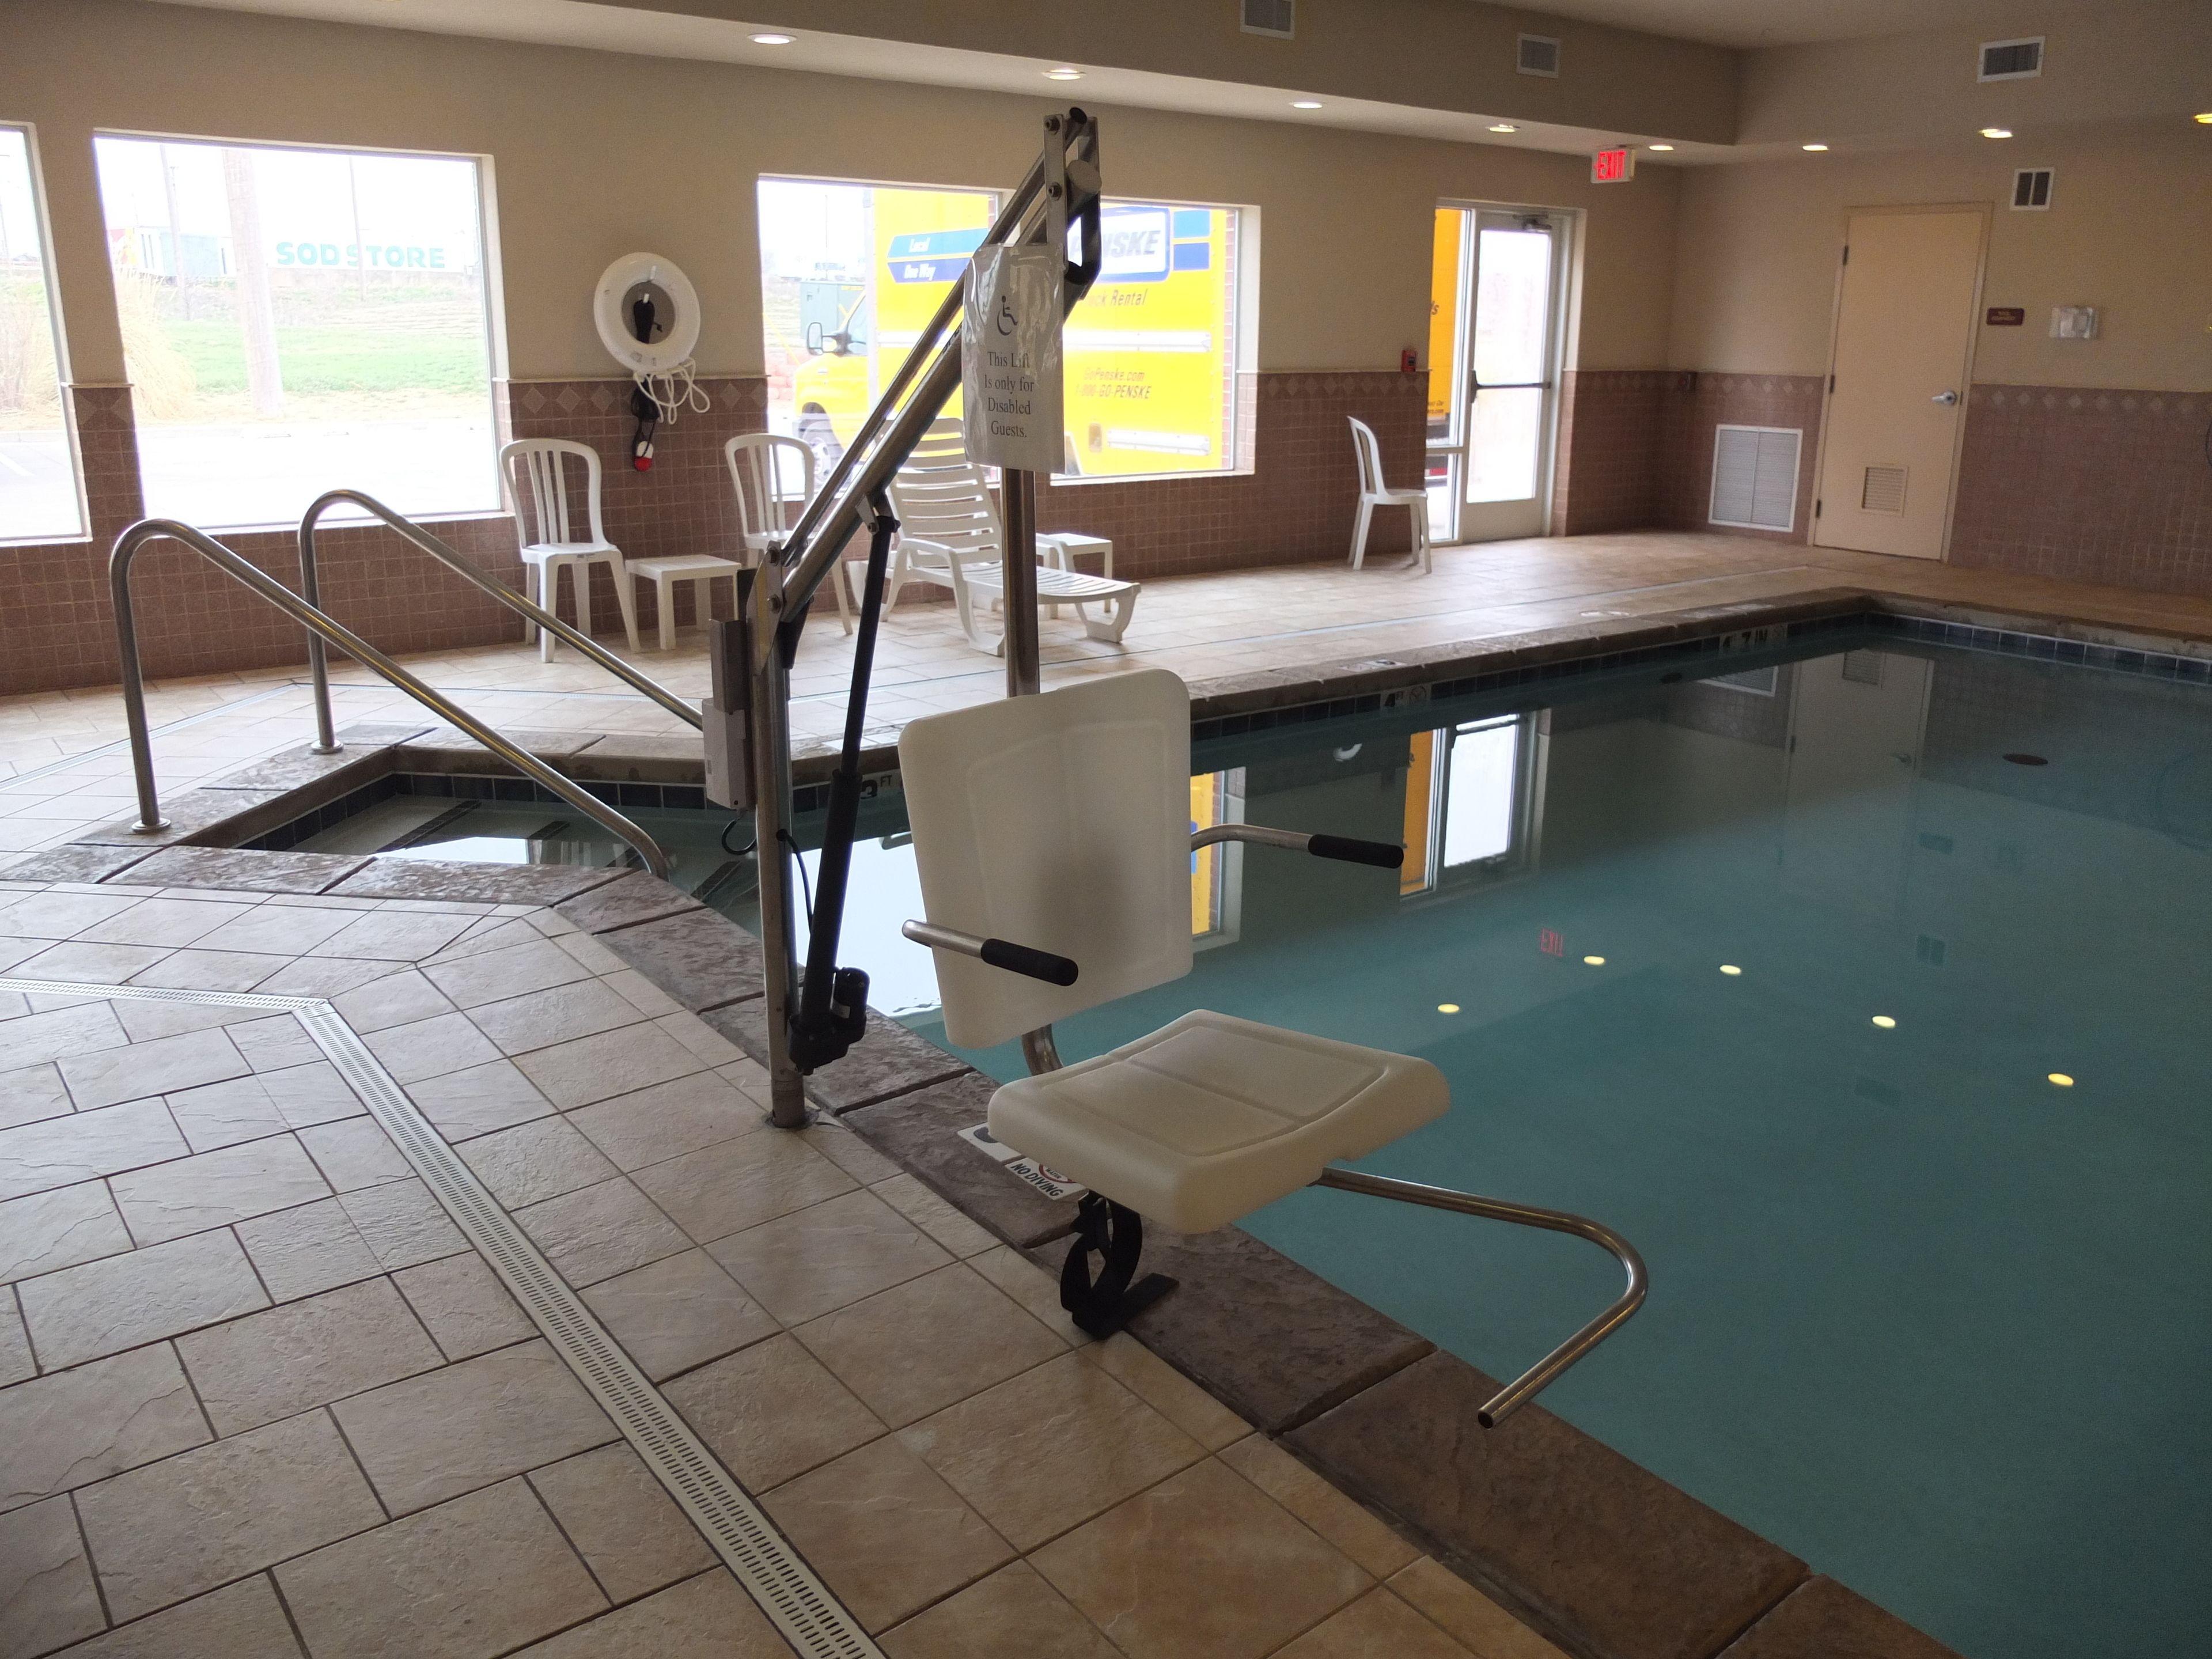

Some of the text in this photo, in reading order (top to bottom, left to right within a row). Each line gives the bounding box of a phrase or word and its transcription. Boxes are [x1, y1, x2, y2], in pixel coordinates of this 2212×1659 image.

[1597, 150, 1626, 180] EXIT
[908, 237, 931, 253] Local
[276, 242, 445, 268] SOD STORE
[904, 263, 936, 281] One Way
[1111, 289, 1148, 306] Rental
[987, 351, 1030, 368] This Lift
[1084, 368, 1145, 381] GoPenske.com
[984, 374, 1034, 394] Is only for
[988, 397, 1031, 415] Disabled
[991, 421, 1027, 438] Guests.
[880, 775, 892, 787] FT
[1010, 1163, 1063, 1196] NO DIVING
